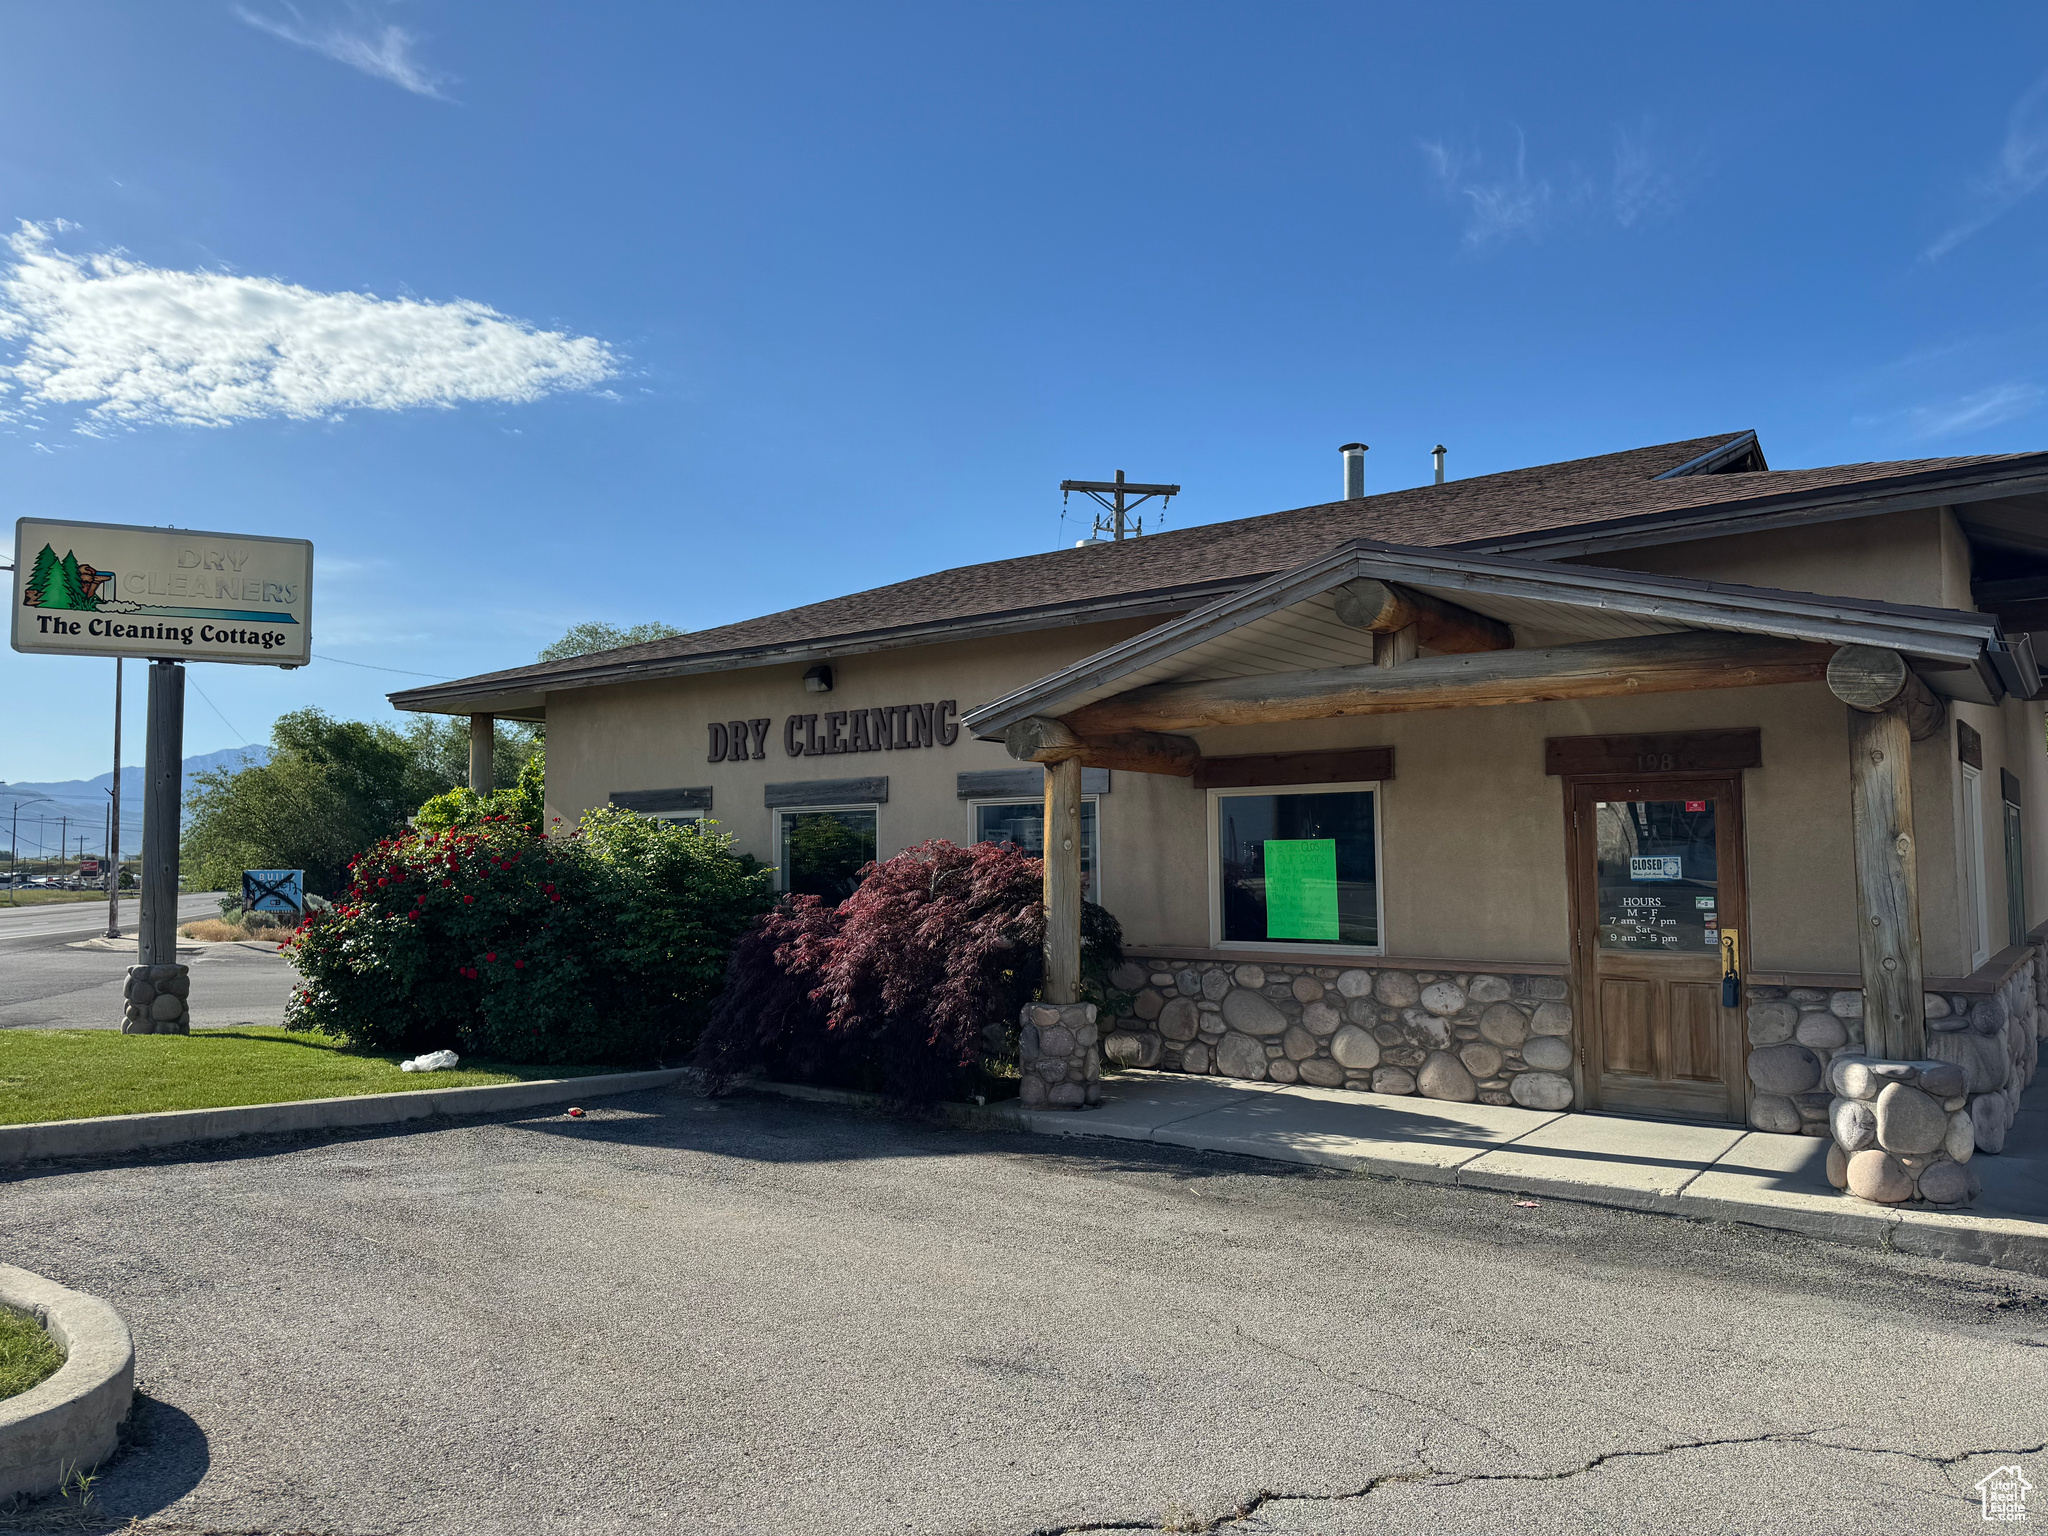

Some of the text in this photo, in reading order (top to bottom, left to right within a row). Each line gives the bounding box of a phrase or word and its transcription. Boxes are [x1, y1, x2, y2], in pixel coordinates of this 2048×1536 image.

[177, 547, 249, 572] DRY
[123, 570, 299, 604] CLEANERS
[37, 615, 286, 649] The Cleaning Cottage
[707, 700, 959, 762] DRY CLEANING
[1632, 859, 1662, 870] CLOSED
[1623, 897, 1661, 906] HOURS
[1627, 909, 1638, 917] M
[1651, 909, 1658, 917] F
[1610, 917, 1617, 925] 7
[1649, 917, 1656, 925] 7
[1660, 919, 1677, 927] pm
[1635, 926, 1651, 934] Sat
[1610, 934, 1617, 942] 9
[1650, 934, 1657, 942] 5
[1661, 936, 1678, 944] pm
